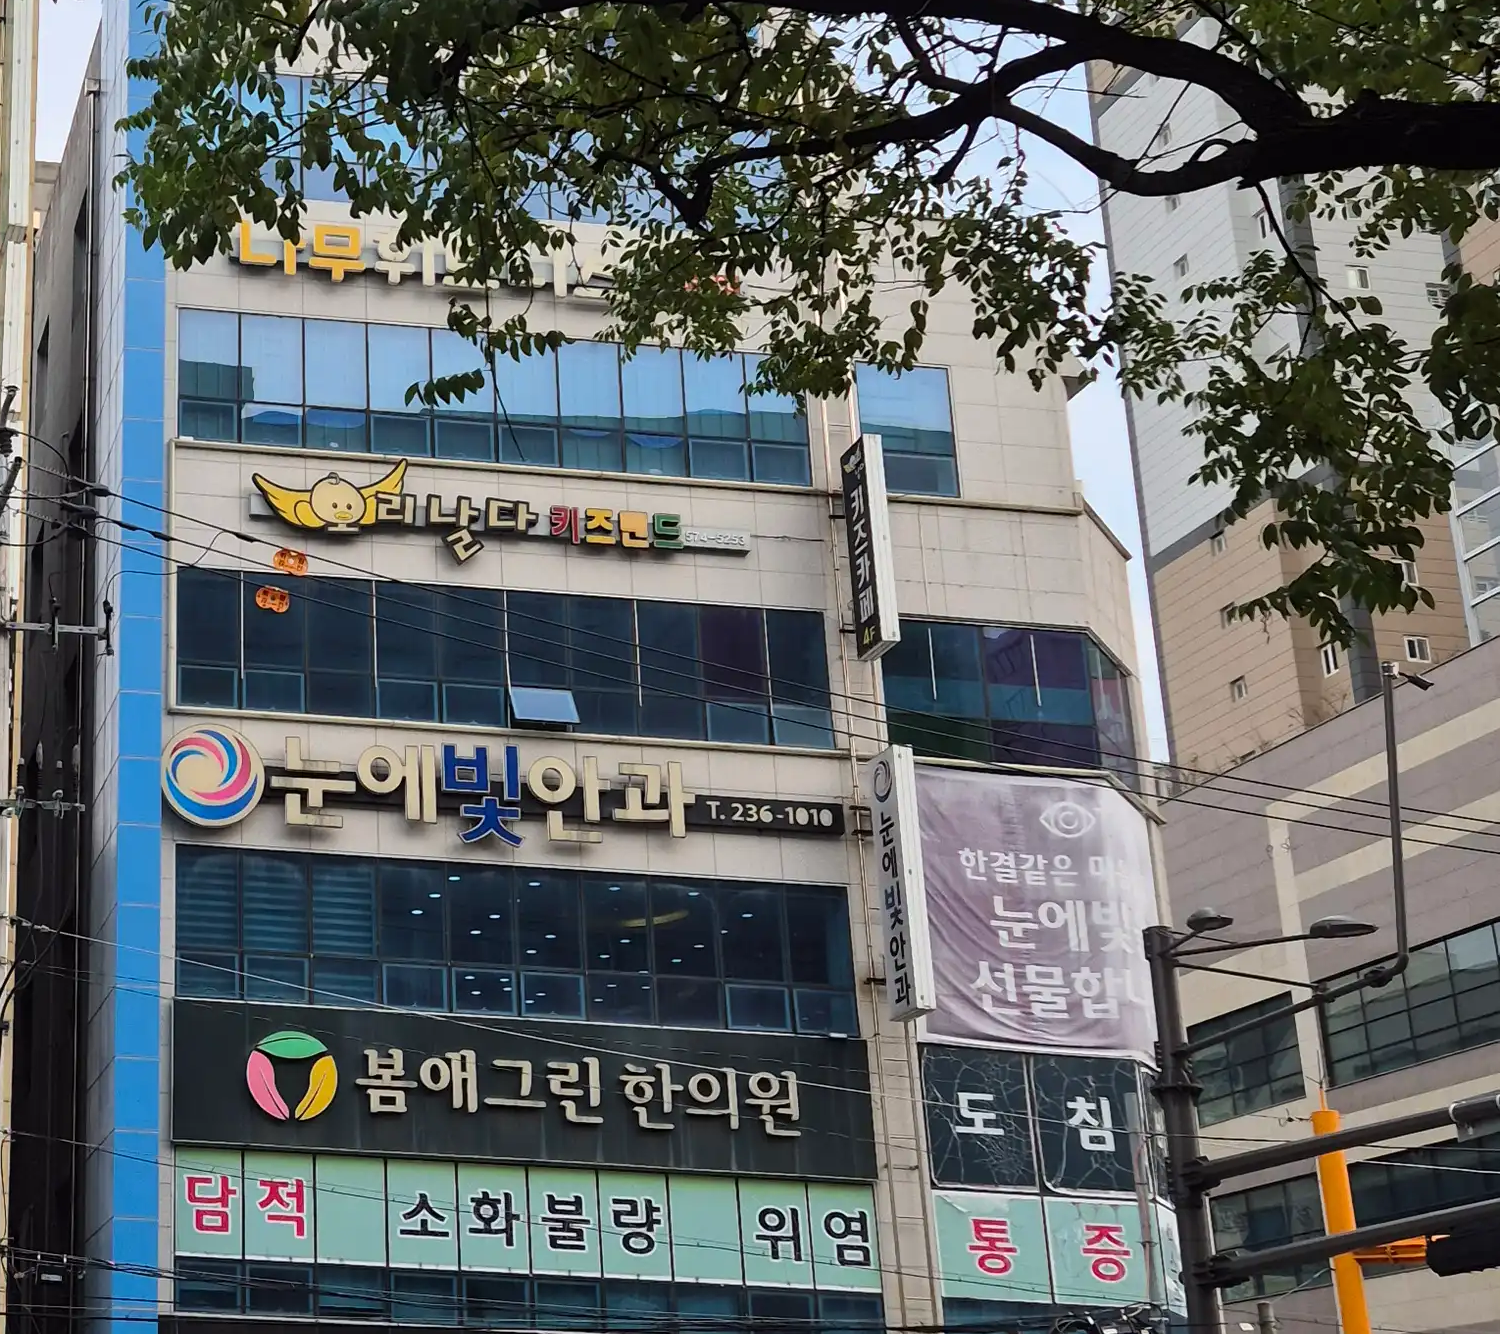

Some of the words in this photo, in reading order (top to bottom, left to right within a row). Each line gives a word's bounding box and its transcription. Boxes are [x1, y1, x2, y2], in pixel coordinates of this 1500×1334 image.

[850, 487, 875, 624] 키즈카페
[862, 624, 877, 647] 4F
[269, 735, 696, 848] 눈에빛안과
[730, 800, 834, 828] 236-1010
[875, 808, 913, 1008] 눈에빛안과
[958, 847, 1079, 887] 한결같은
[355, 1046, 604, 1126] 봄애그린
[619, 1062, 802, 1138] 한의원
[184, 1173, 309, 1239] 담적
[397, 1188, 664, 1257] 소화불량
[754, 1203, 871, 1268] 위염
